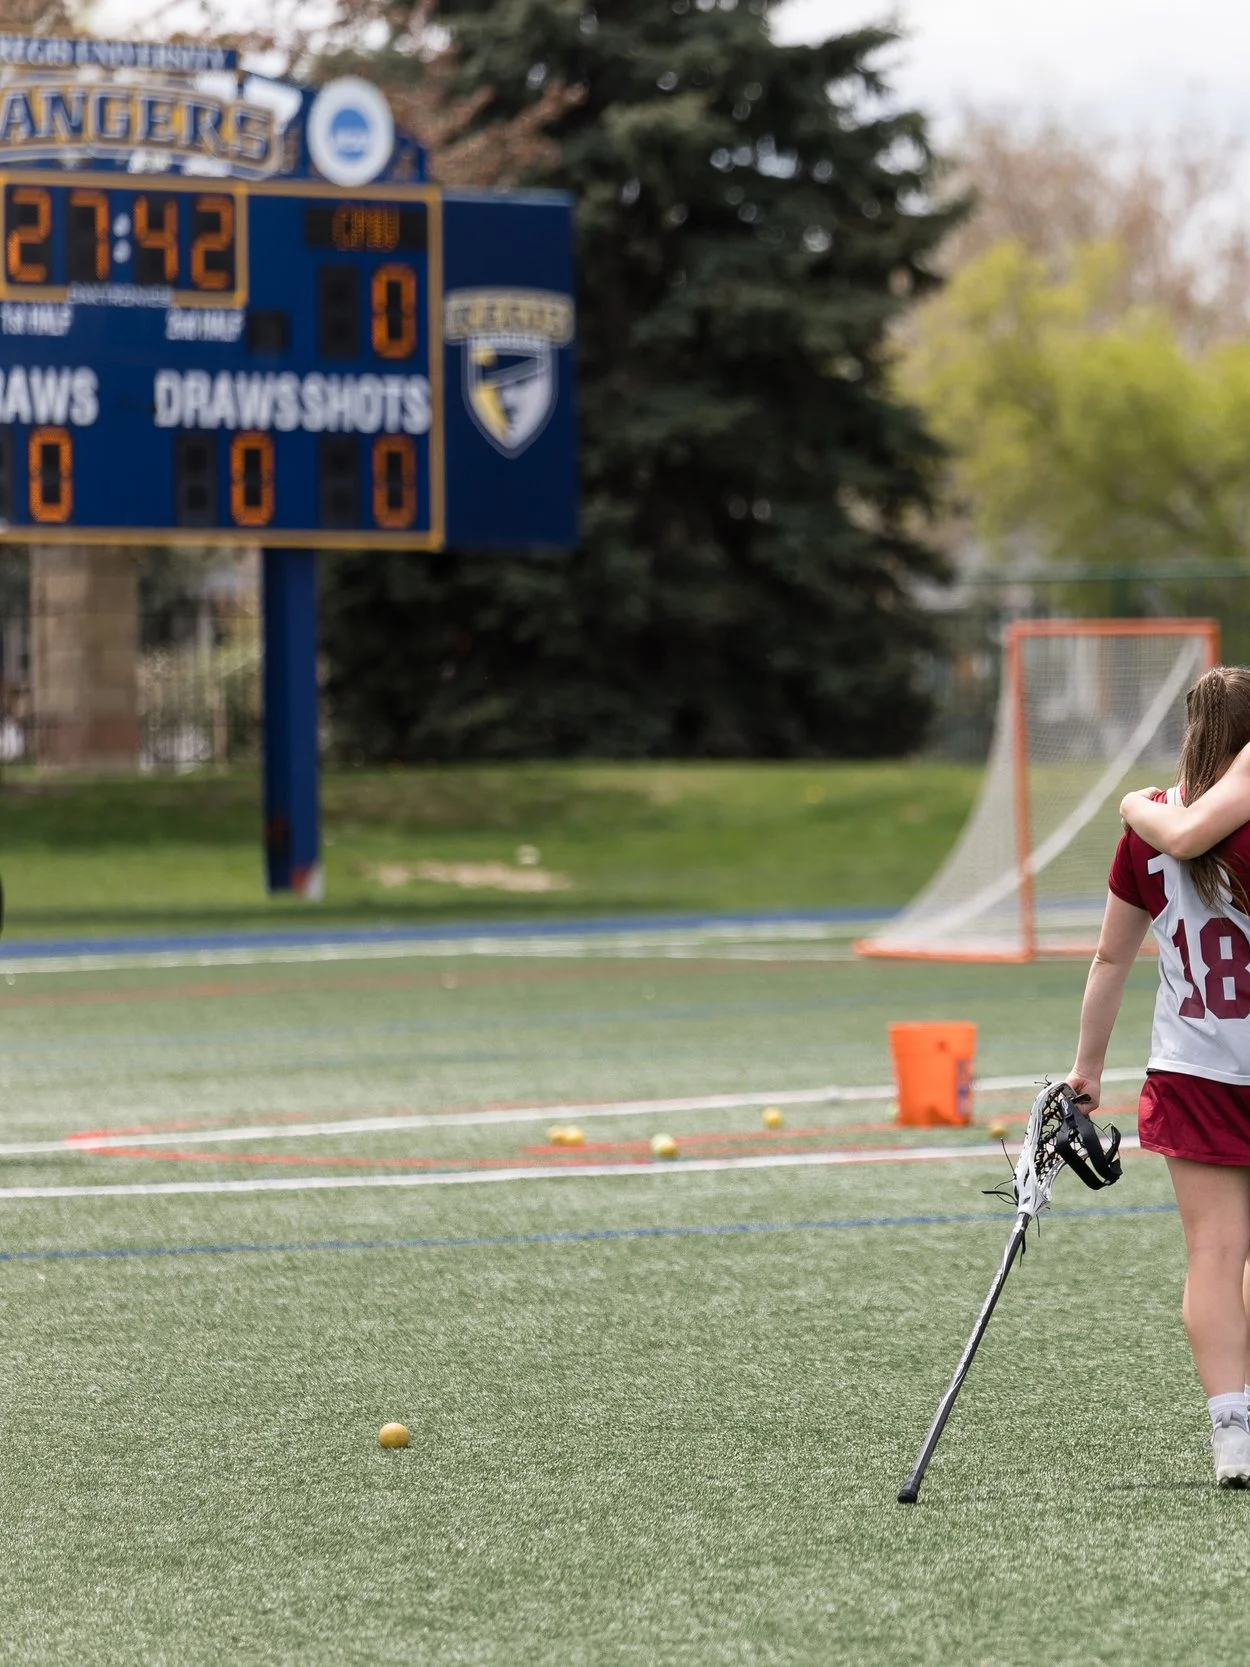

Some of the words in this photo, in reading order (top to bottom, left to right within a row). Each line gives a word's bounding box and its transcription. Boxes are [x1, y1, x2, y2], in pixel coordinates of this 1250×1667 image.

[8, 187, 234, 290] 27:42
[371, 264, 416, 358] 0
[154, 369, 299, 431] DRAWS
[301, 371, 430, 434] SHOTS
[29, 427, 73, 522] 0
[231, 431, 274, 526] 0
[373, 434, 416, 529] 0
